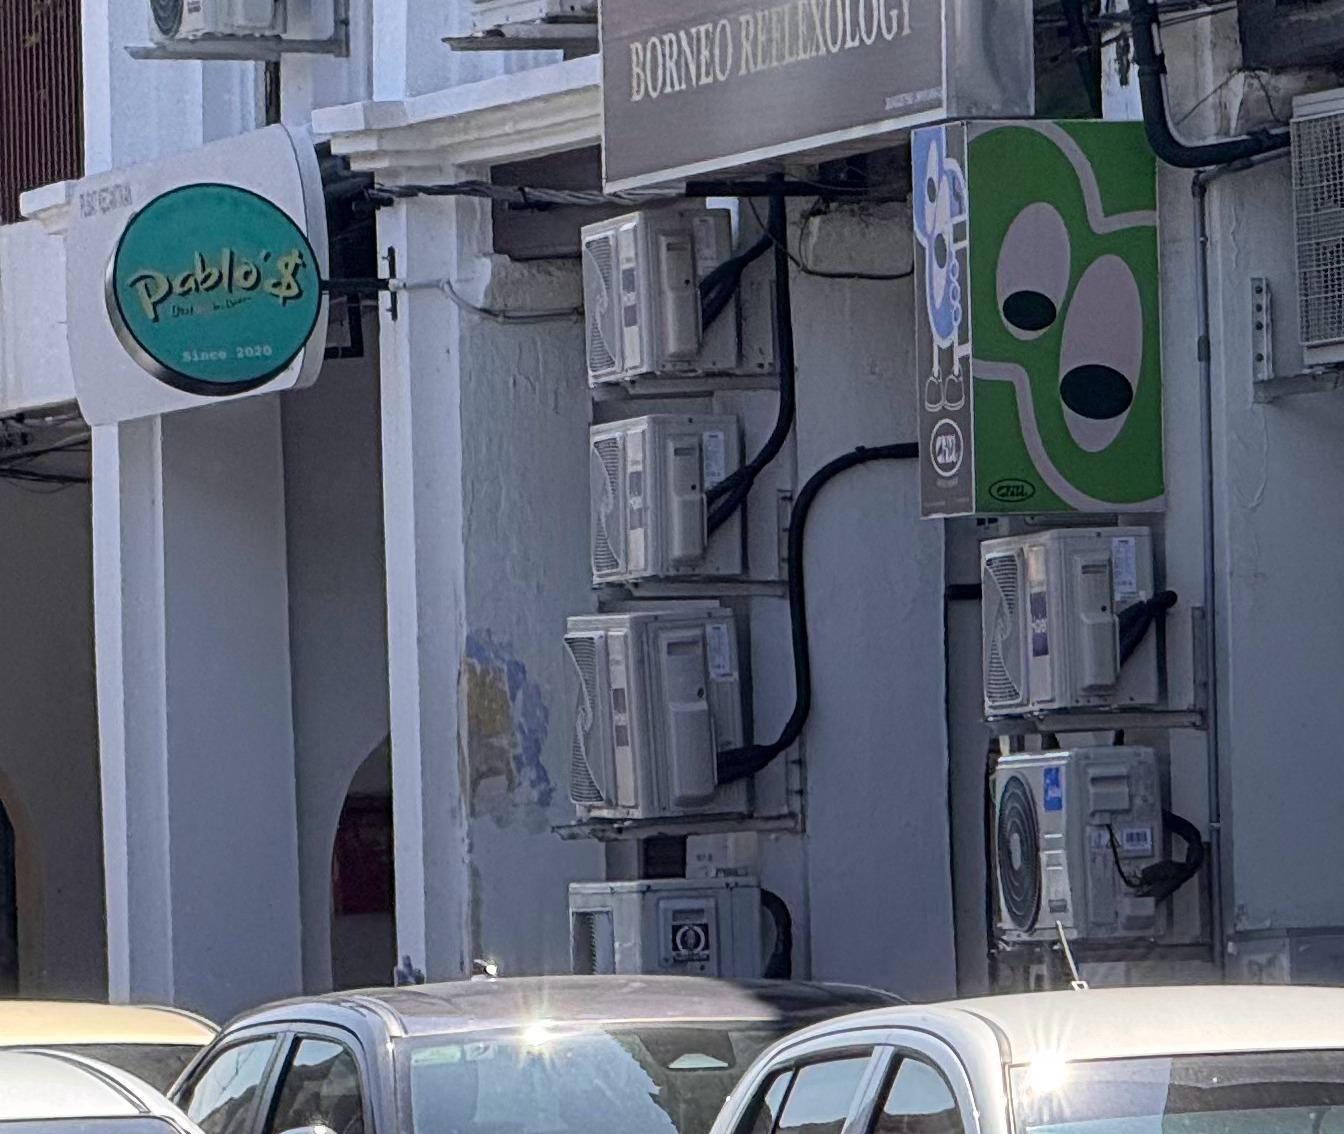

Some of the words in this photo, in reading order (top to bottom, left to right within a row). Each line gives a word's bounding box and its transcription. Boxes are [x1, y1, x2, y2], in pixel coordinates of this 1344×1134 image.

[630, 18, 734, 102] BORNEO
[182, 349, 227, 362] Since
[236, 345, 273, 358] 2020
